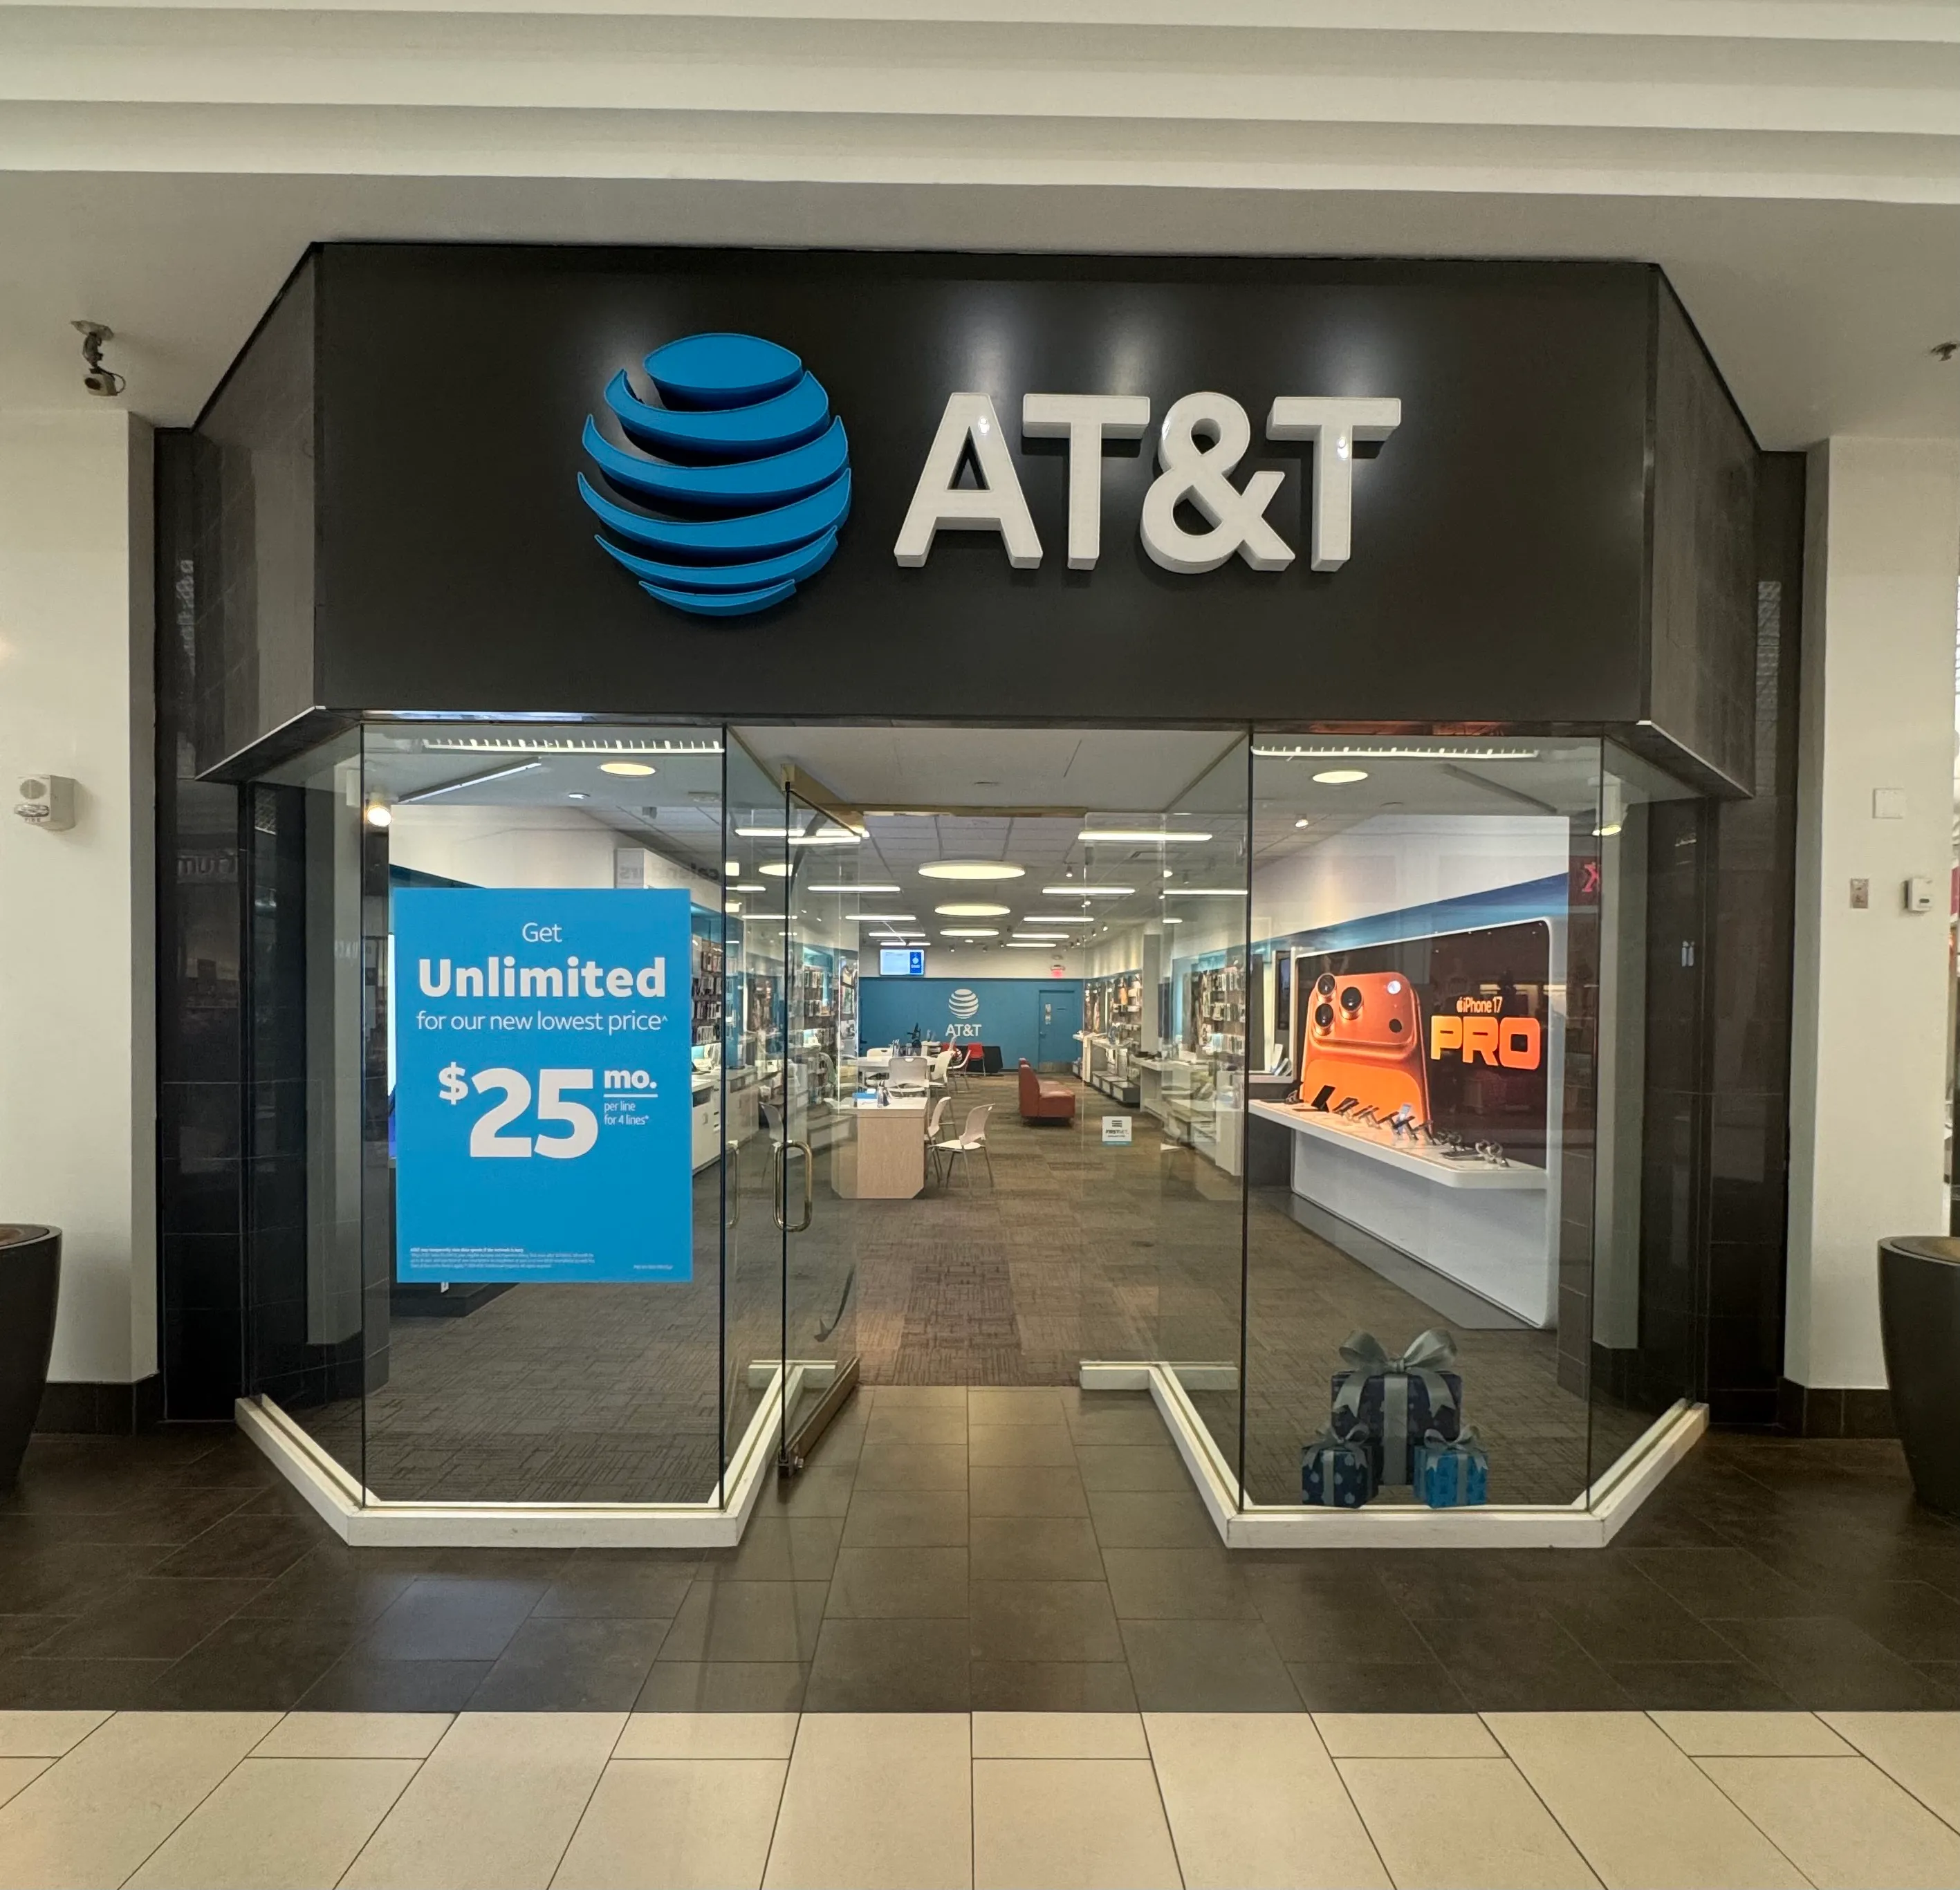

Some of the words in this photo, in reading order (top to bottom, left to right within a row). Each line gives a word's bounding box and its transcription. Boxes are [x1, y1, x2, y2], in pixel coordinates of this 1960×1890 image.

[894, 391, 1403, 574] AT&T
[522, 922, 562, 943] Get
[418, 956, 665, 998] Unlimited
[1463, 997, 1492, 1013] iPhone
[1492, 996, 1503, 1013] 17
[416, 1010, 447, 1030] for
[450, 1015, 486, 1030] our
[490, 1015, 533, 1030] new
[537, 1010, 604, 1030] lowest
[945, 1023, 982, 1037] AT&T
[1430, 1015, 1541, 1070] PRO
[438, 1062, 599, 1159] $25
[604, 1070, 658, 1089] mo.
[604, 1102, 618, 1113] per
[620, 1100, 636, 1111] line
[604, 1114, 617, 1125] for
[618, 1114, 624, 1125] 4
